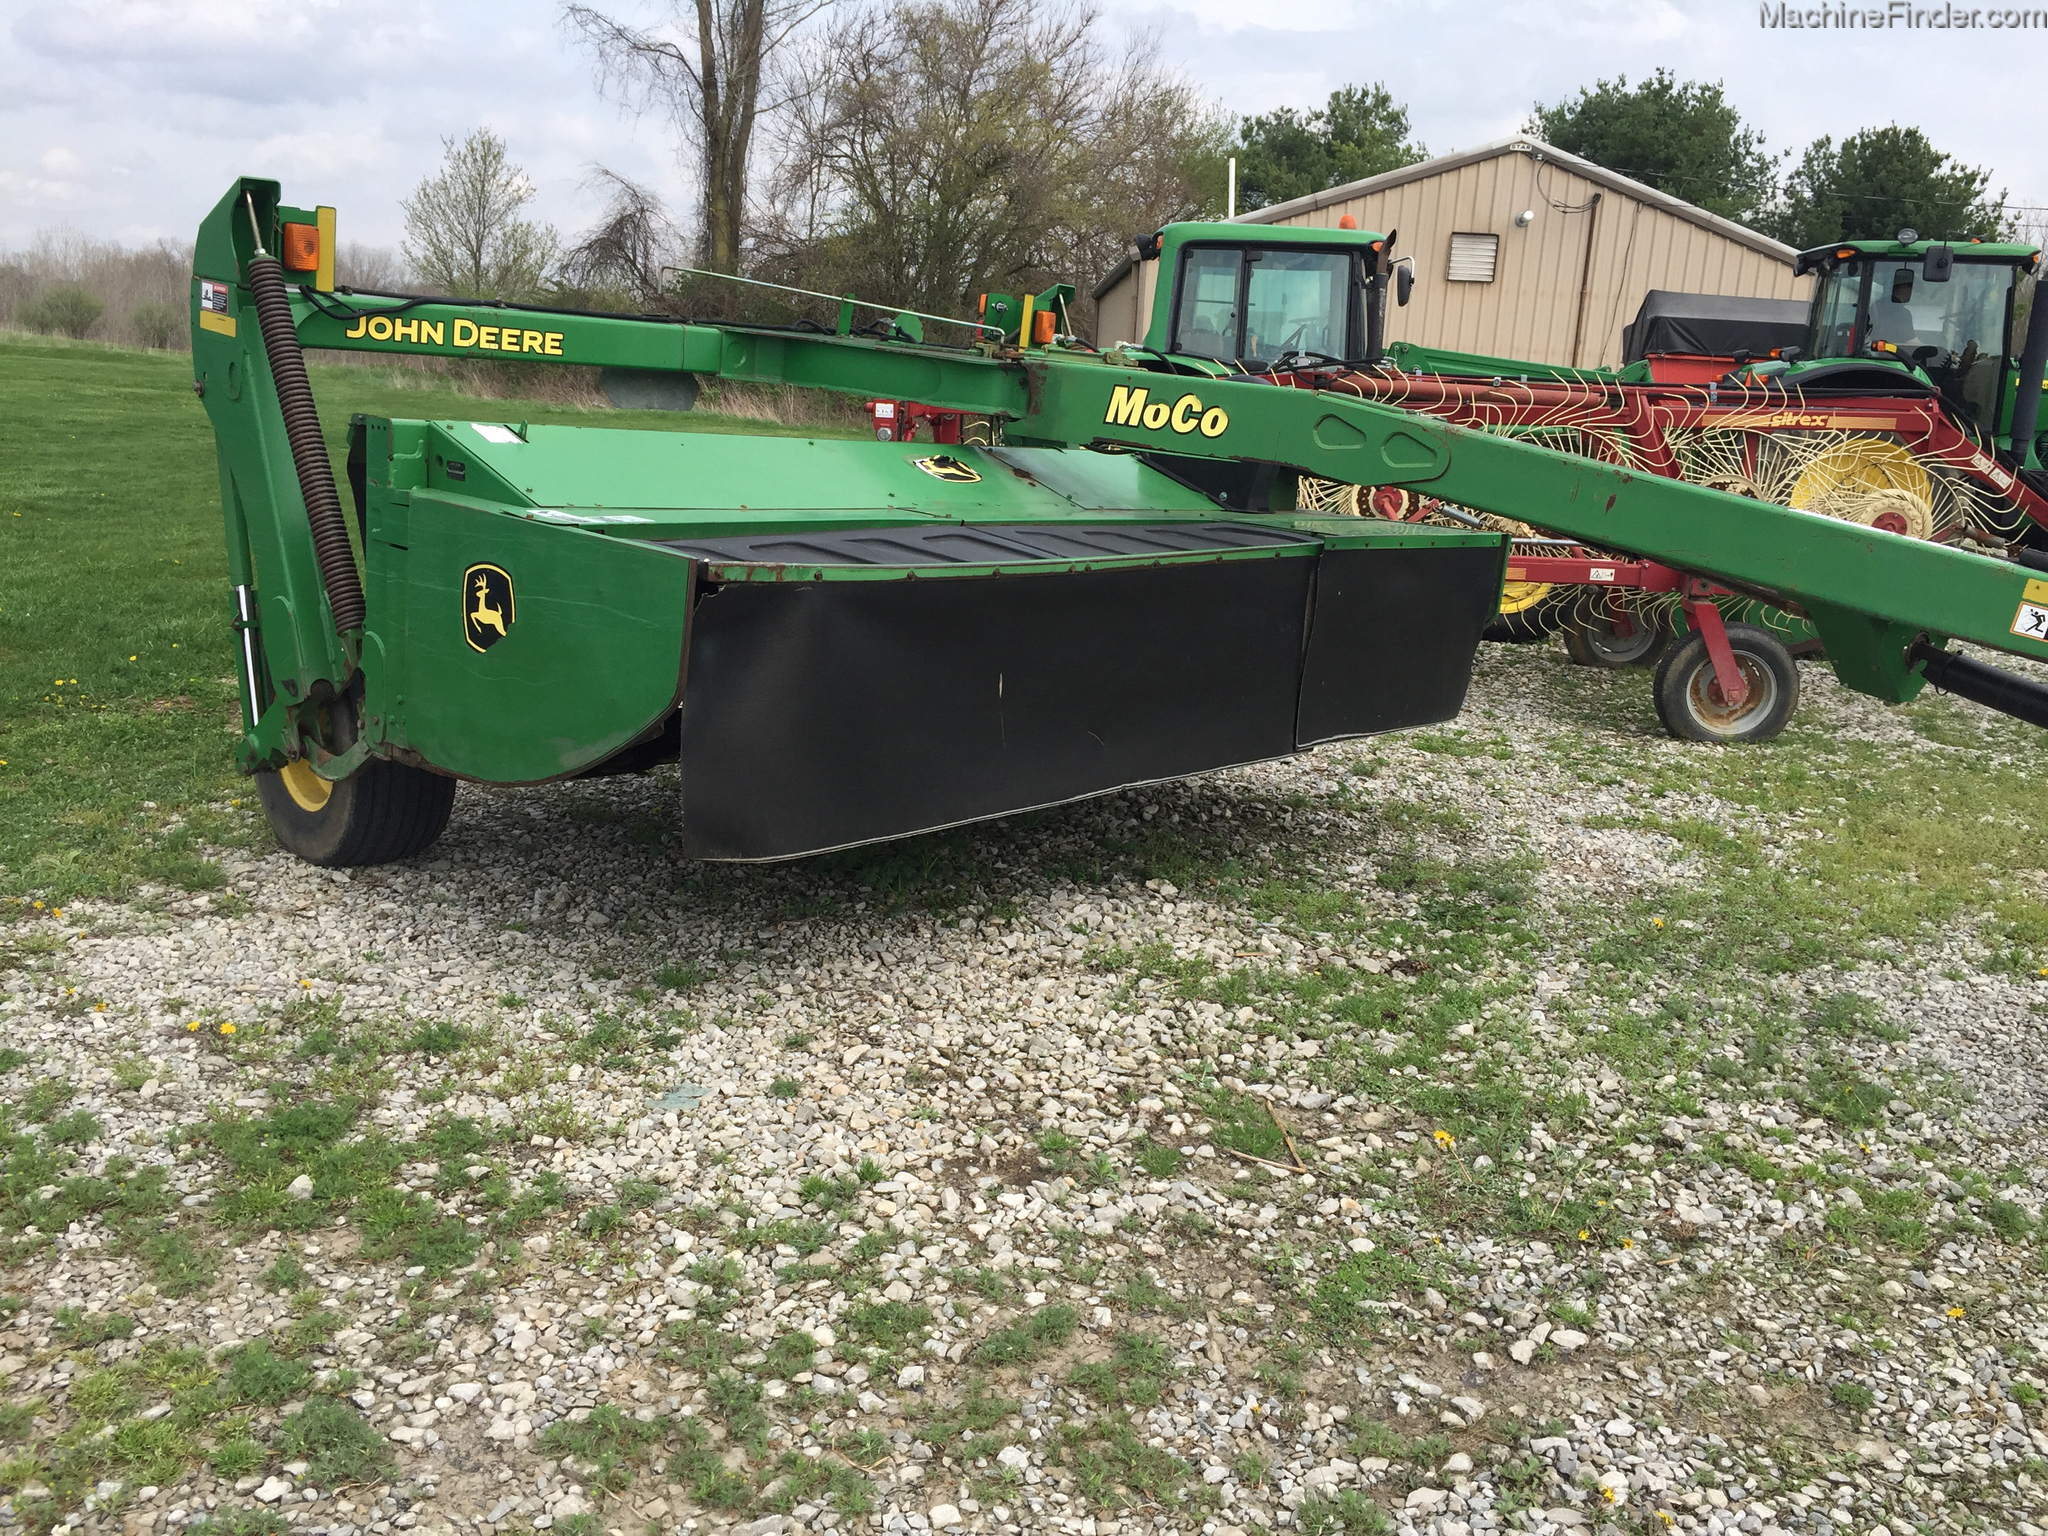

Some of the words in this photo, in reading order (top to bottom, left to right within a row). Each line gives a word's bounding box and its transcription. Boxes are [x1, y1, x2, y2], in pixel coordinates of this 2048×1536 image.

[346, 315, 445, 345] JOHN
[453, 318, 564, 356] DEERE
[1103, 385, 1229, 438] MoCo
[1770, 412, 1828, 427] sitrex
